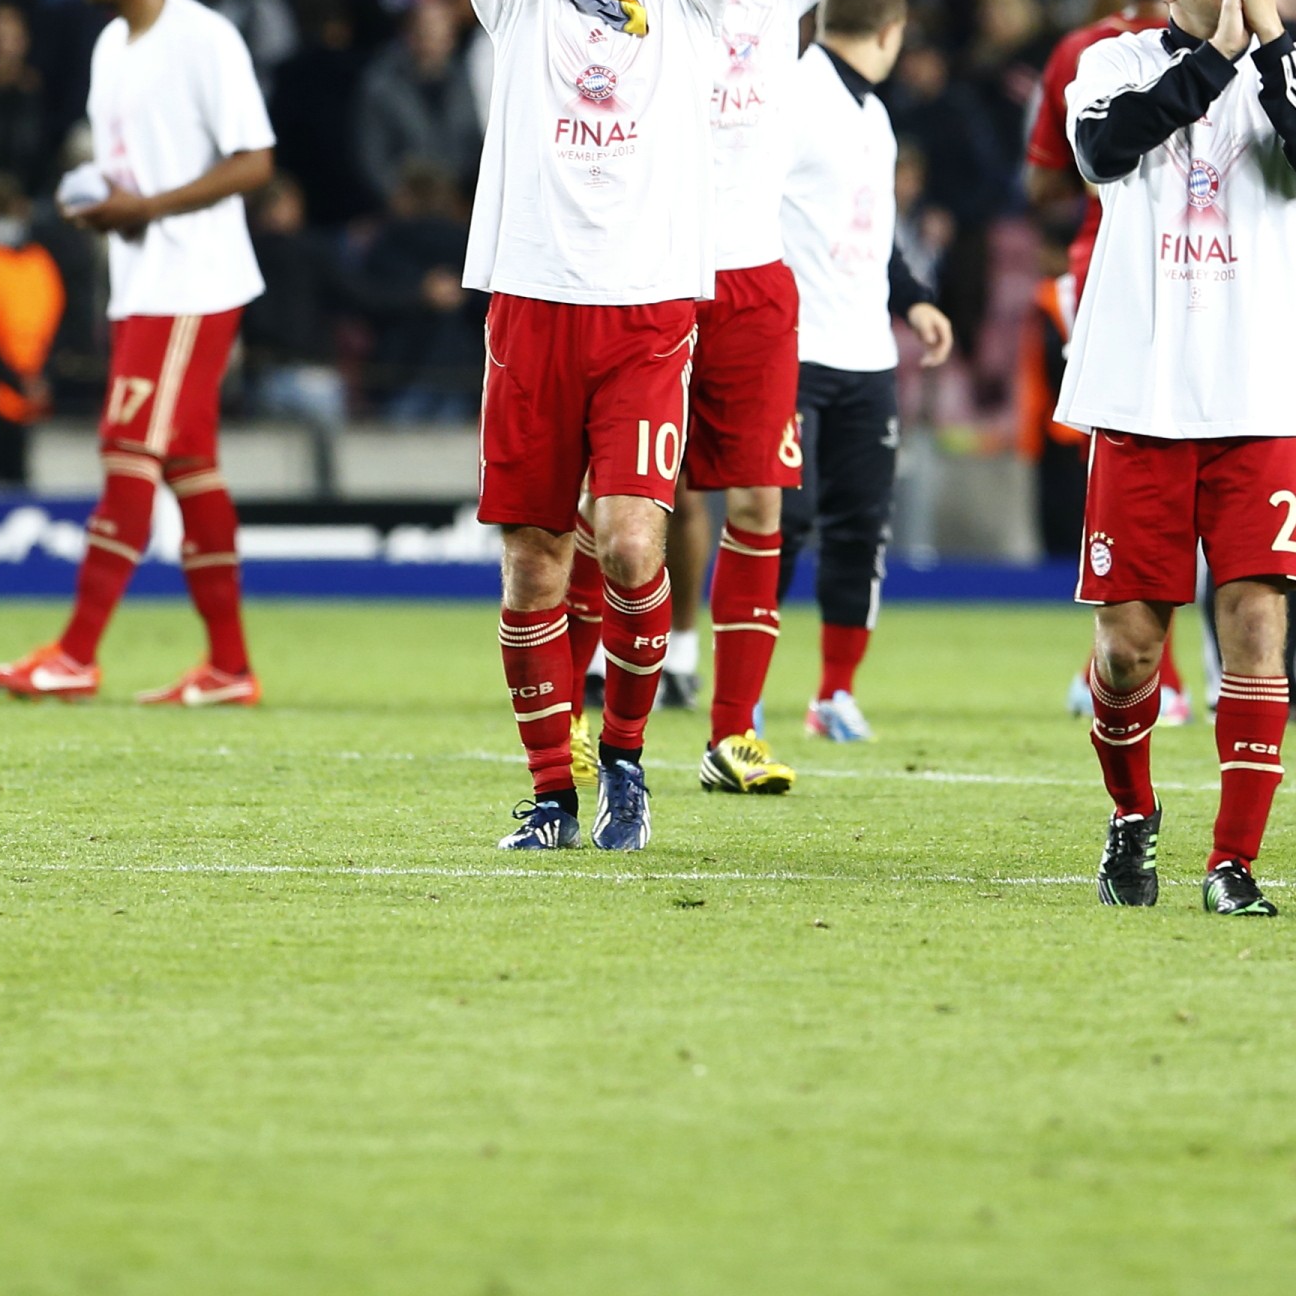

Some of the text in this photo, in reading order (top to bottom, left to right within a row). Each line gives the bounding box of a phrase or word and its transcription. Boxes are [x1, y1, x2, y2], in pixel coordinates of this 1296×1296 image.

[555, 118, 638, 147] FINAL
[556, 144, 636, 162] WEMBLEY 2013
[1160, 233, 1238, 264] FINAL
[108, 377, 154, 426] 17
[636, 419, 679, 481] 10
[508, 680, 555, 701] FCB
[1233, 741, 1279, 756] FCB
